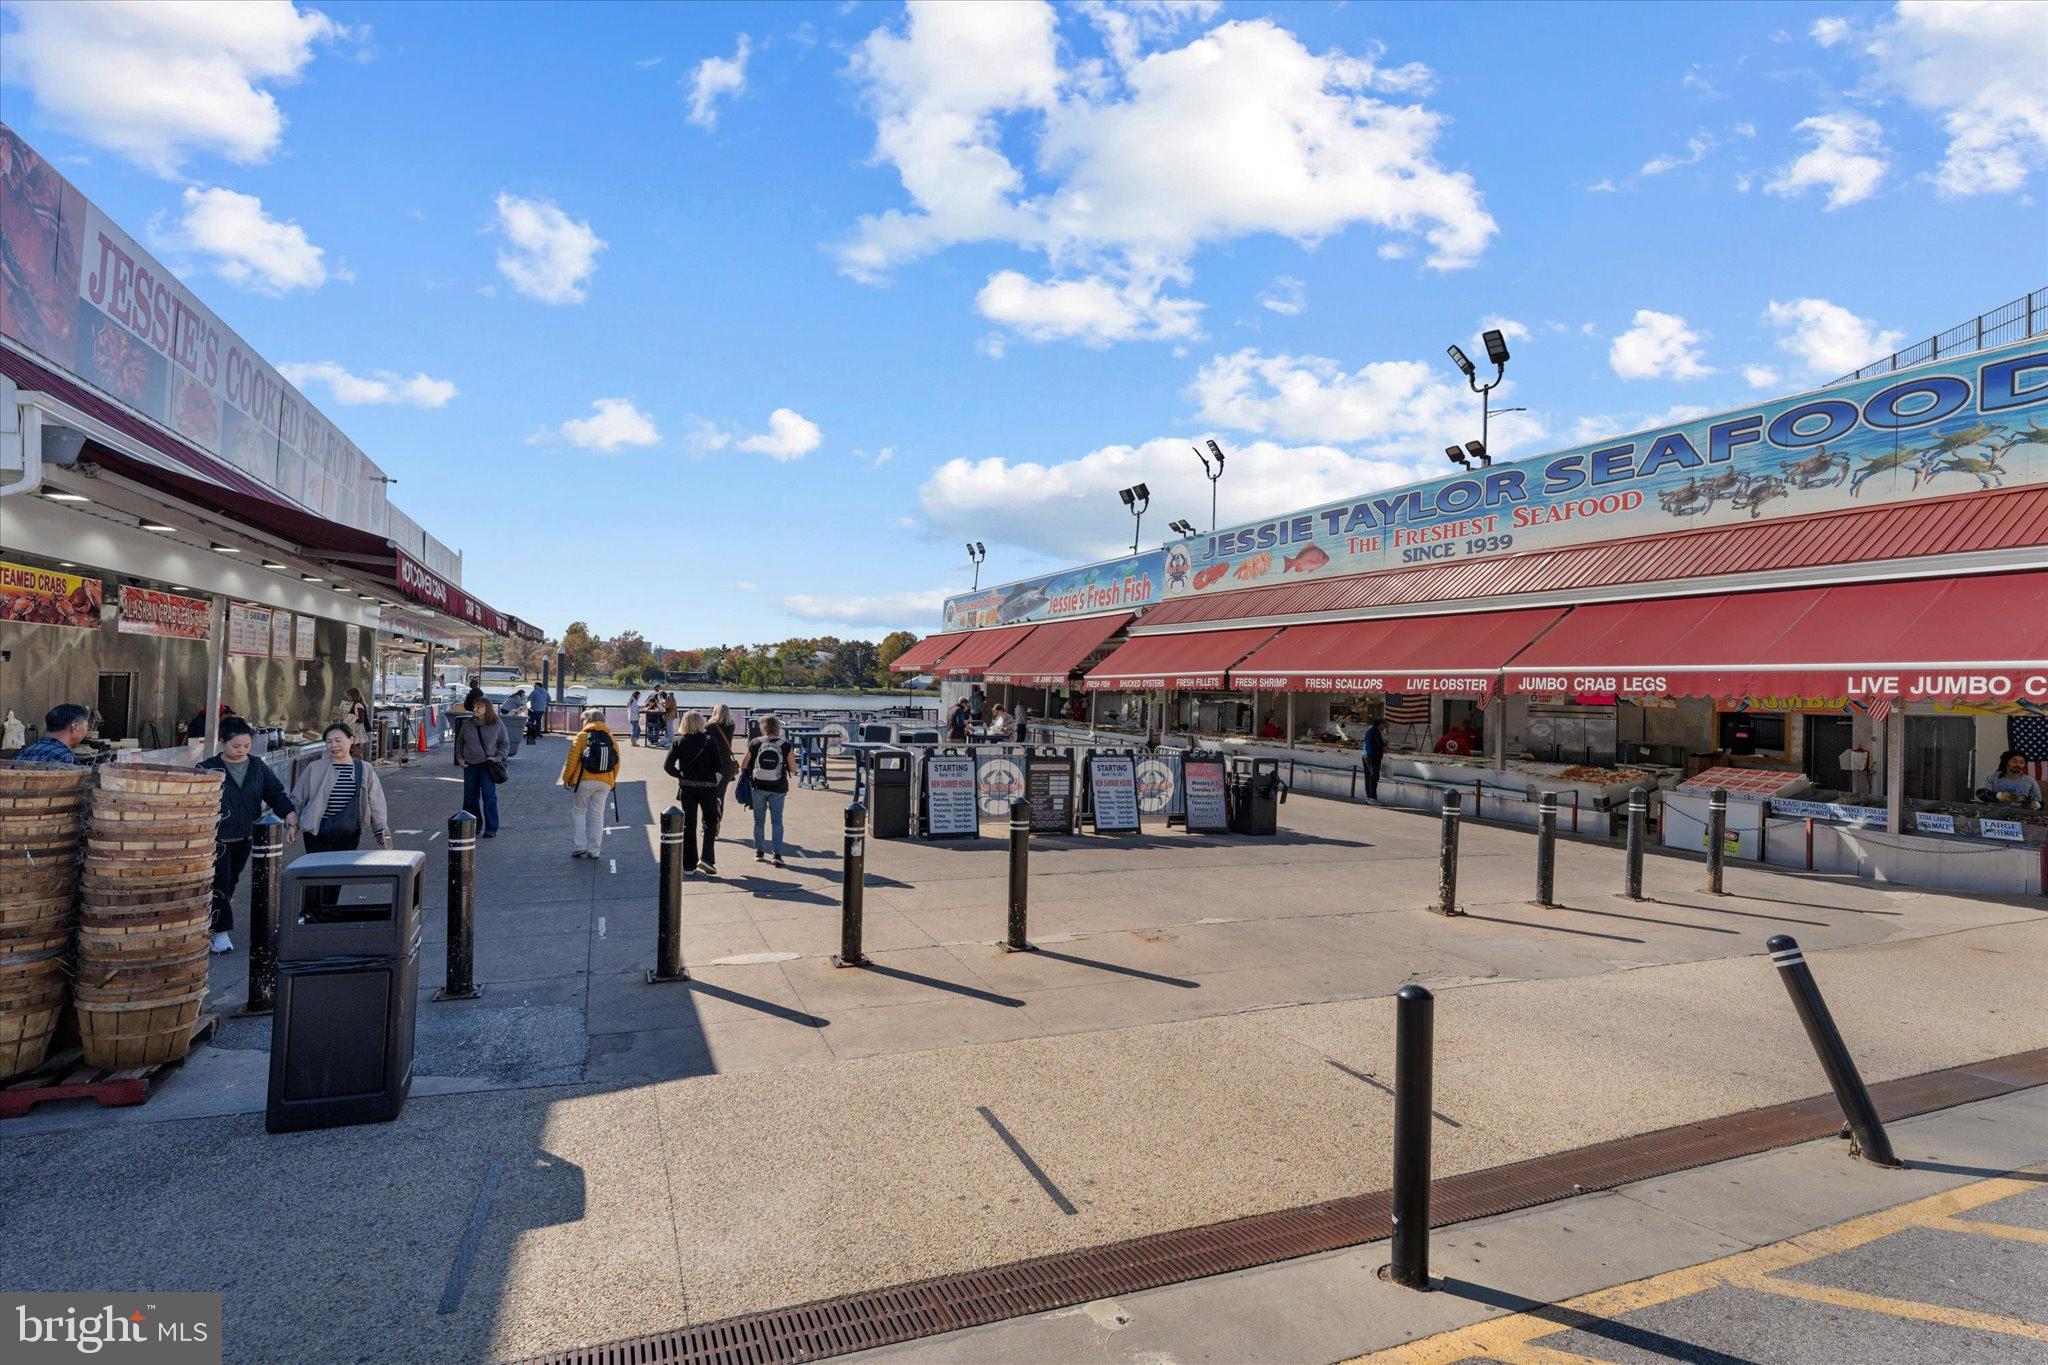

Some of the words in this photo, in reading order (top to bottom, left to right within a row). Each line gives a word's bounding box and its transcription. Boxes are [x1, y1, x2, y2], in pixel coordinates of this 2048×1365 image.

[88, 231, 220, 388] JESSIE'S
[226, 346, 299, 446] COOKED
[1202, 515, 1314, 560] JESSIE
[1321, 469, 1529, 537] TAYLOR
[1346, 533, 1382, 555] THE
[1512, 490, 1643, 529] SEAFOOD
[1402, 540, 1456, 564] SINCE
[1465, 534, 1514, 555] 1939
[38, 573, 67, 595] CRABS
[1047, 589, 1084, 614] Jessie's
[1087, 579, 1120, 608] Fresh
[1122, 573, 1151, 603] Fish
[1119, 679, 1141, 688] SHUCKED
[1142, 679, 1165, 688] OYSTERS
[1175, 678, 1195, 687] FRESH
[1195, 677, 1219, 687] FILLETS
[1235, 677, 1257, 687] FRESH
[1259, 677, 1288, 688] SHRIMP
[1305, 678, 1332, 689] FRESH
[1334, 678, 1383, 690] SCALLOPS
[1406, 678, 1431, 690] LIVE
[1432, 678, 1488, 691] LOBSTER
[1518, 677, 1568, 691] JUMBO
[1573, 677, 1617, 690] CRAB
[1623, 677, 1667, 691] LEGS
[1847, 676, 1899, 694] LIVE
[1909, 675, 2012, 695] JUMBO
[934, 764, 969, 772] STARTING
[1096, 764, 1128, 772] STARTING
[1774, 800, 1797, 808] TEXAS
[1833, 805, 1860, 813] JUMBO
[1931, 822, 1950, 830] MALE
[1984, 821, 2018, 830] LARGE
